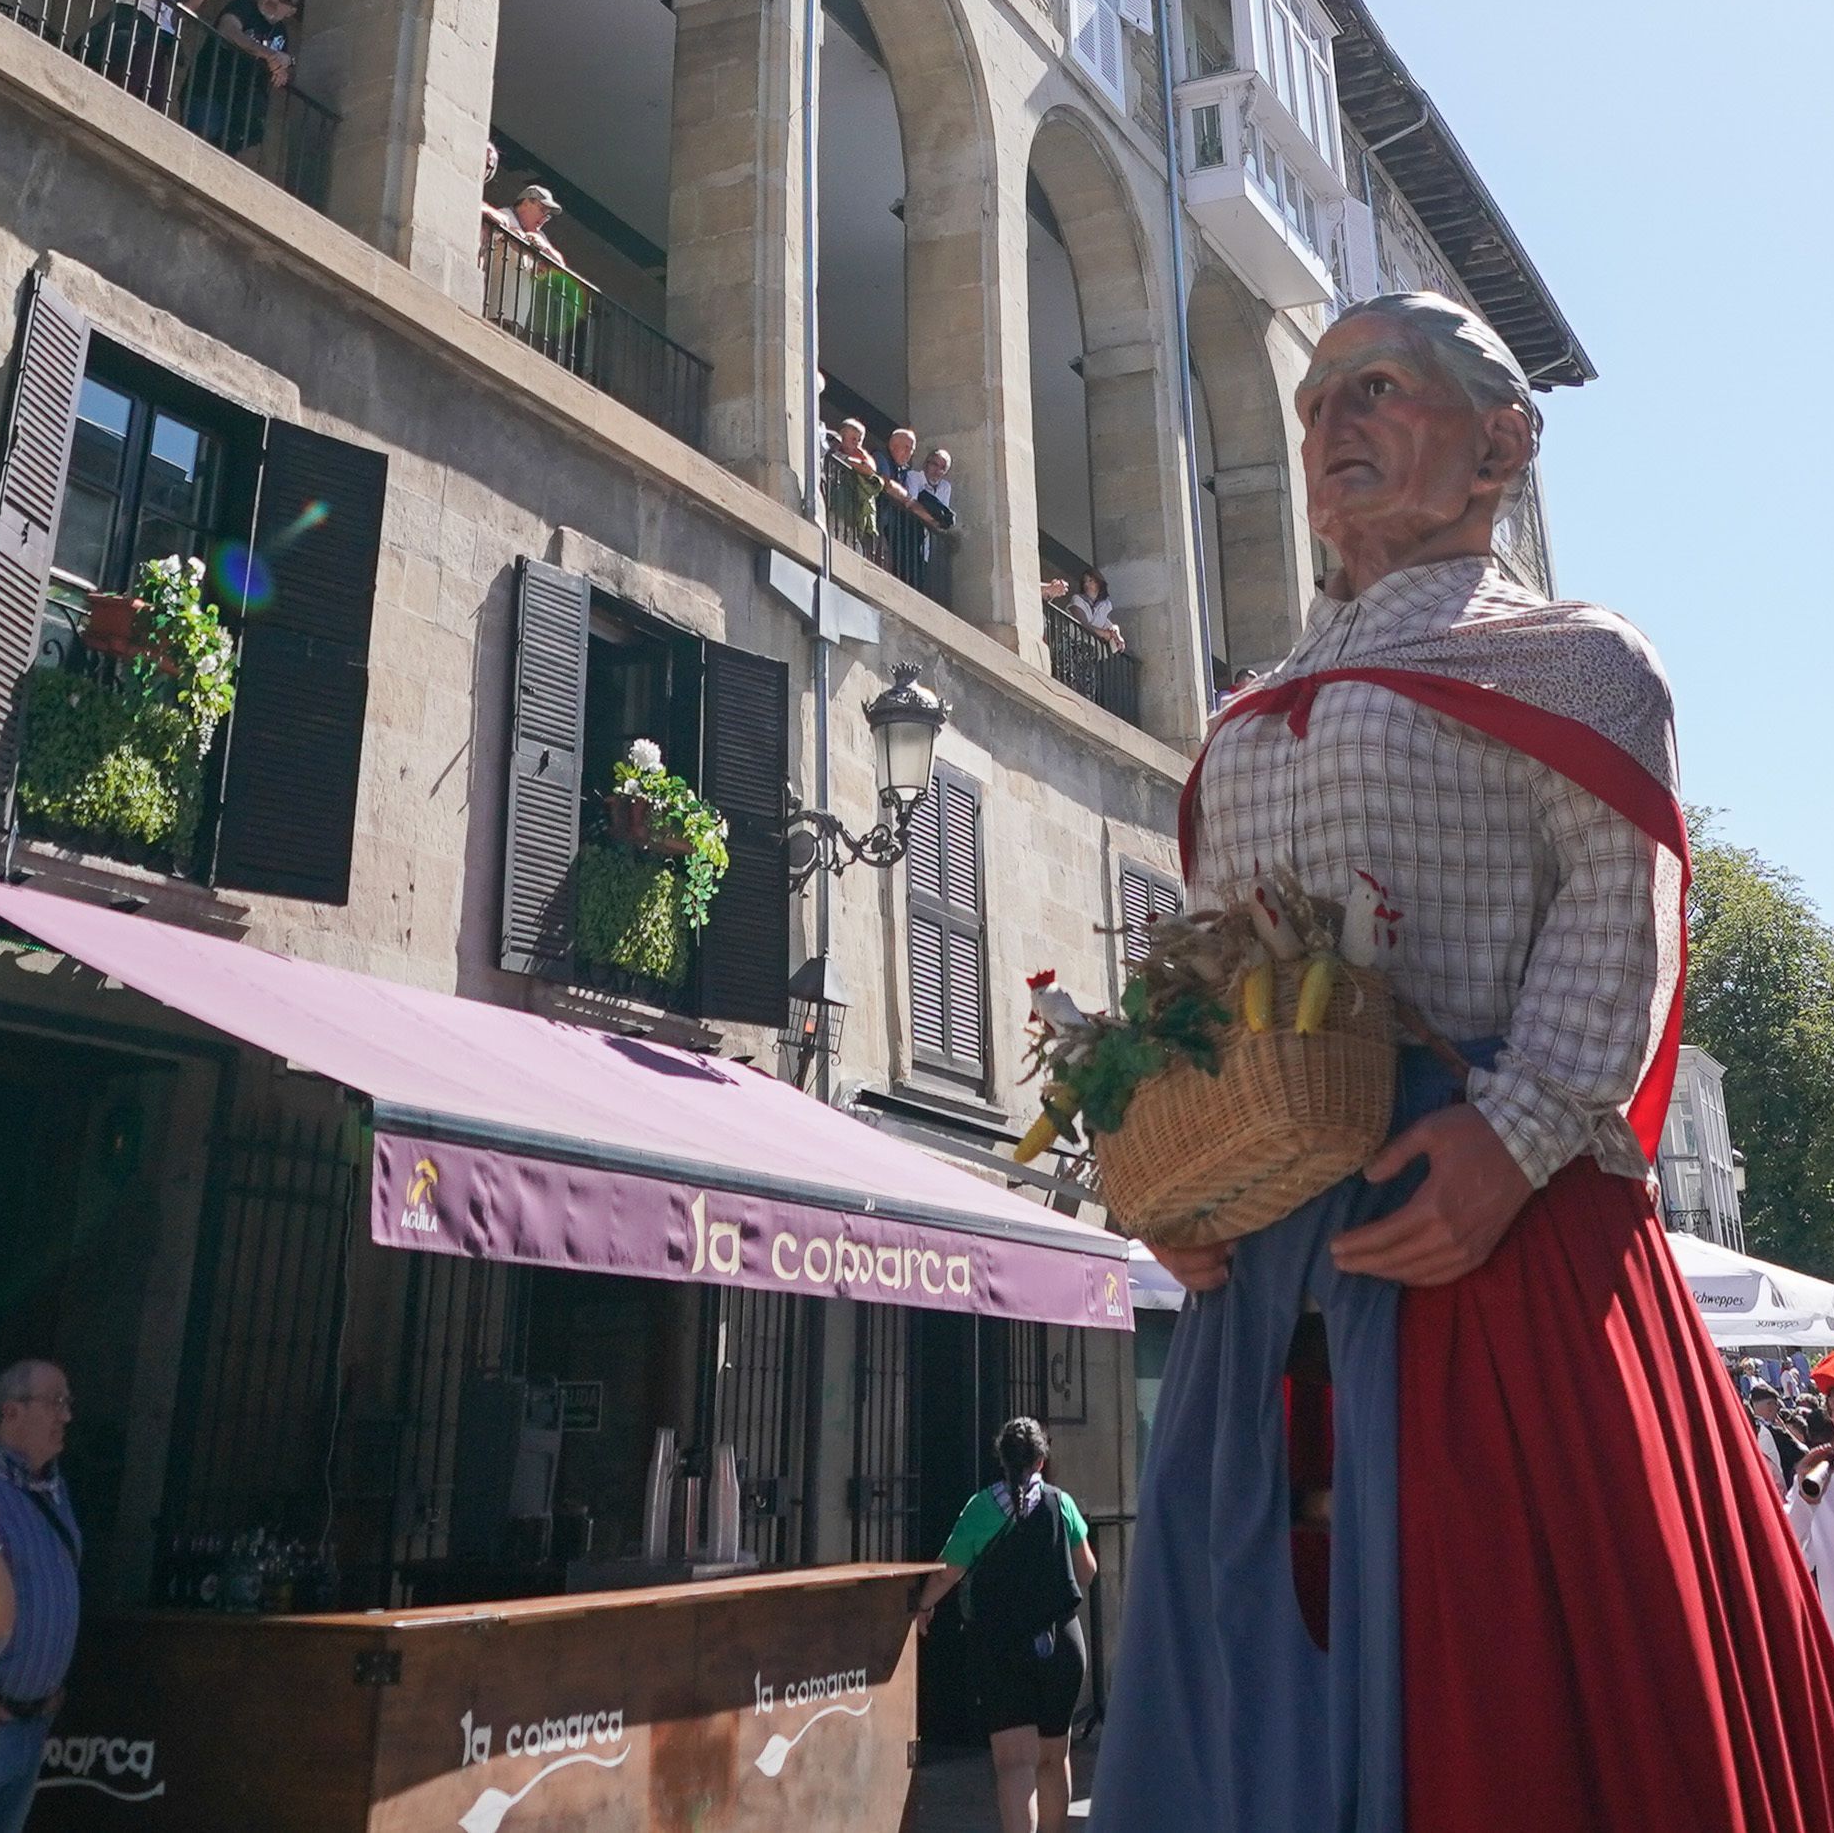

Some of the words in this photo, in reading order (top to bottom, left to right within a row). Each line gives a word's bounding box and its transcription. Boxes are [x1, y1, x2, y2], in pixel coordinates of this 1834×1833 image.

[691, 1191, 743, 1277] la
[771, 1230, 972, 1297] comarca
[1692, 1289, 1745, 1308] Schweppes
[754, 1670, 774, 1716] la
[785, 1668, 867, 1709] comarca
[460, 1709, 492, 1767] la
[505, 1709, 624, 1759] comarca
